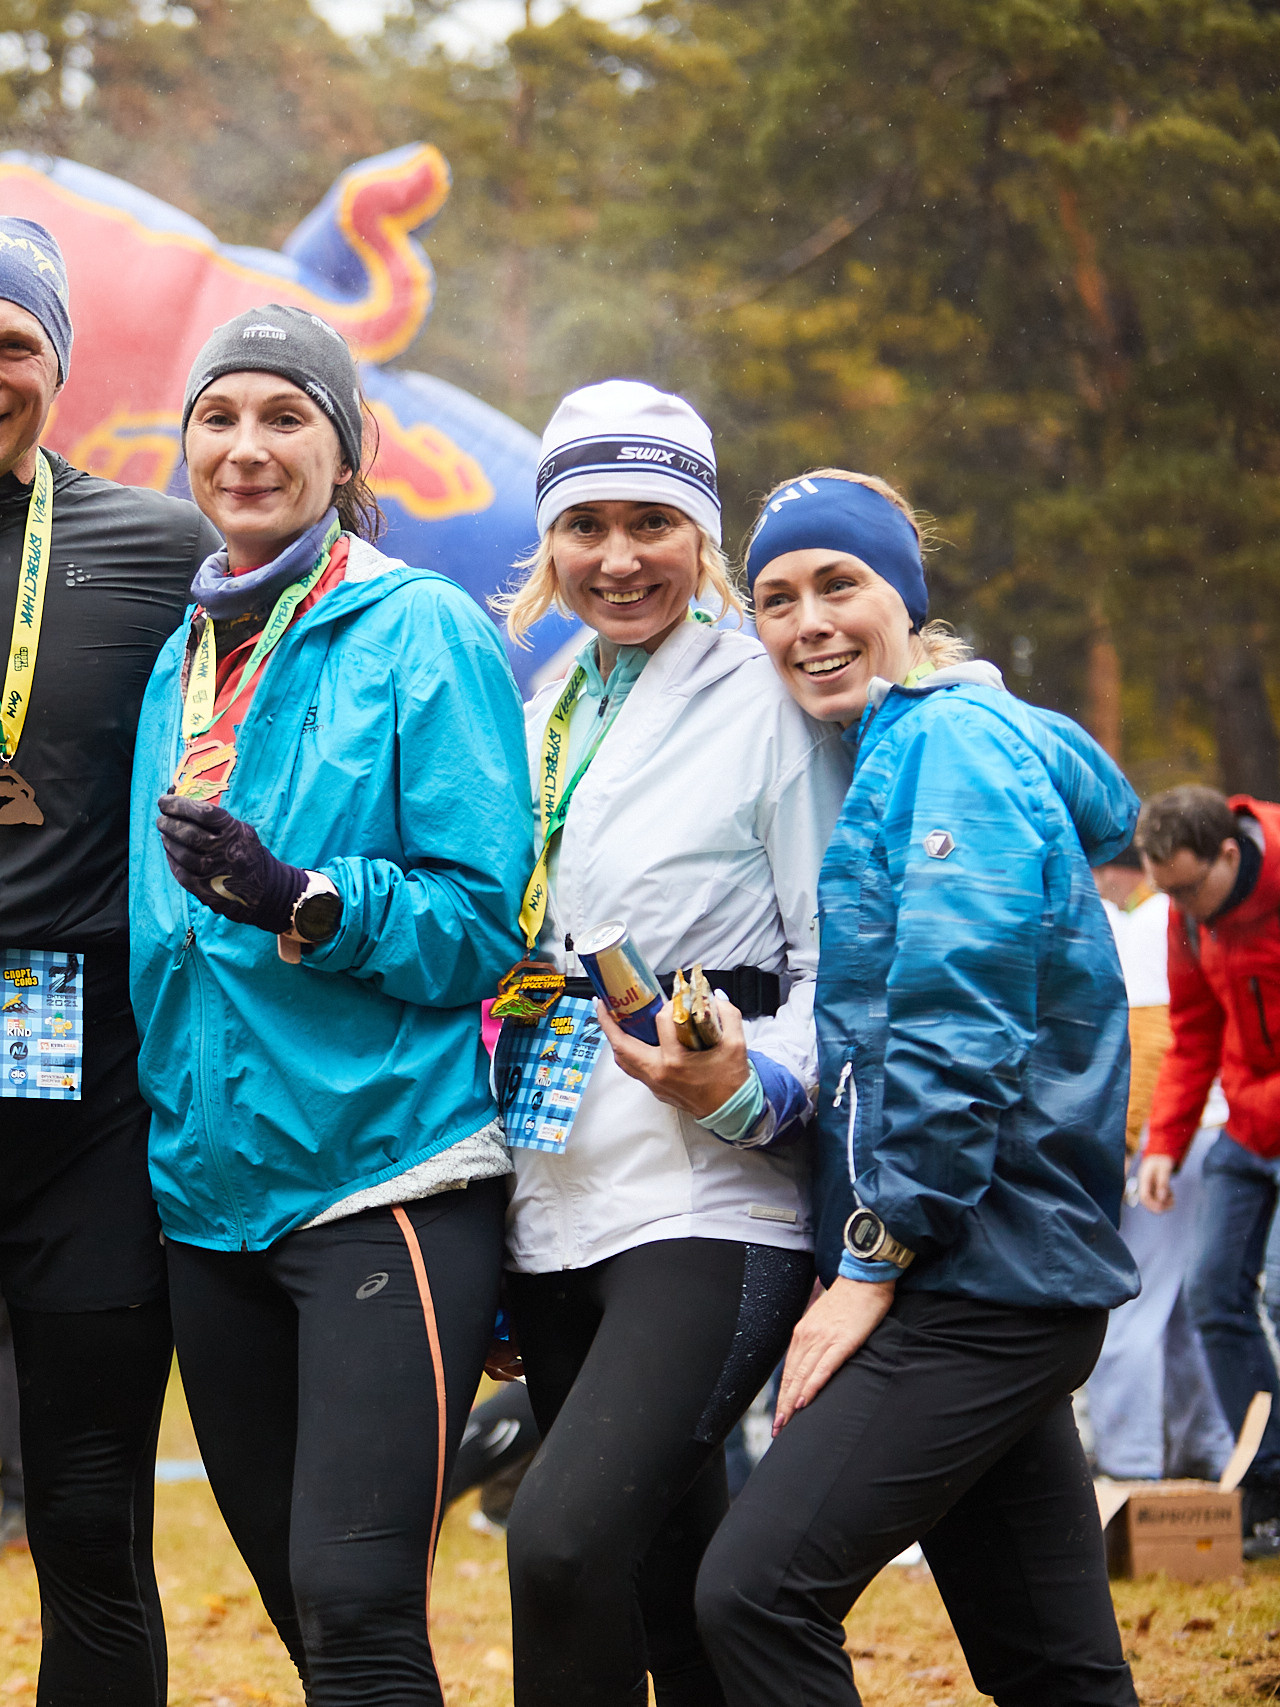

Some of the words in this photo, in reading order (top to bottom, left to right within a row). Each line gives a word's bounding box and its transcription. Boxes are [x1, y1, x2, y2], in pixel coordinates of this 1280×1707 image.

[257, 331, 287, 341] CLUB
[617, 447, 676, 464] SWIX
[4, 968, 31, 980] СПОРТ
[14, 977, 38, 986] СОЮЗ
[607, 987, 639, 1008] Bull
[46, 999, 78, 1008] 2021
[7, 1029, 32, 1037] KIND
